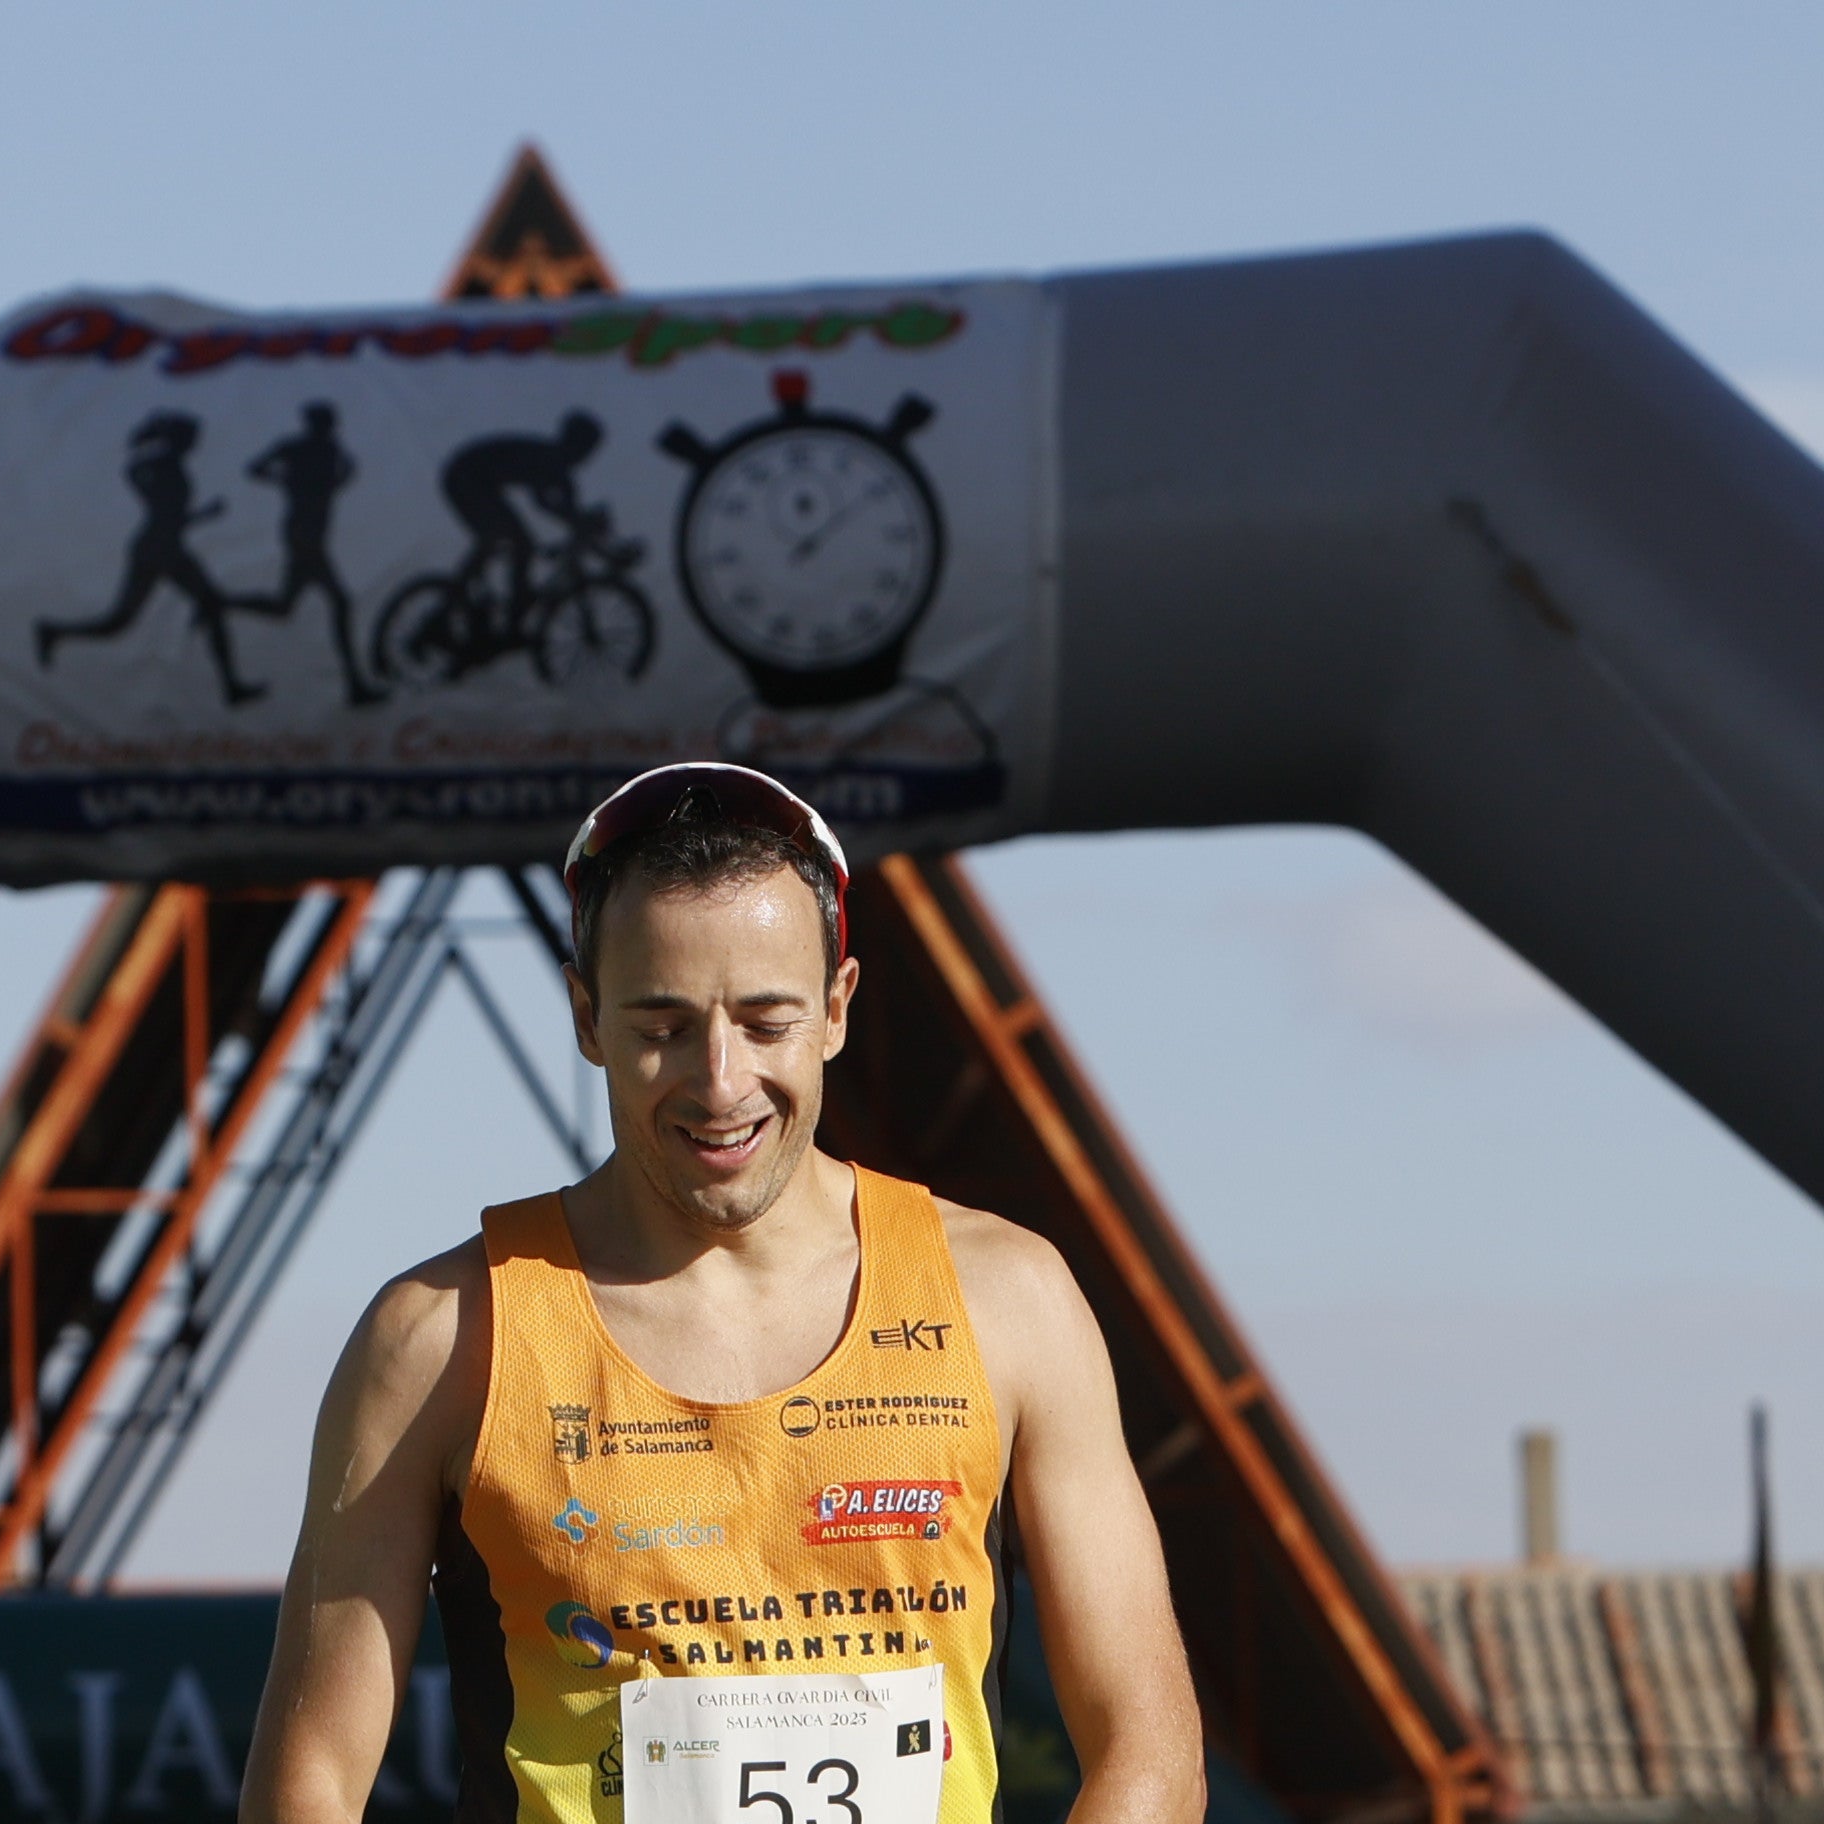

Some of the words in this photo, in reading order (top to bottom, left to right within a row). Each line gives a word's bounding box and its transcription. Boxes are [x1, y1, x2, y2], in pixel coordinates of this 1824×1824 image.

[870, 1319, 952, 1351] EKT
[825, 1398, 876, 1413] ESTER
[881, 1394, 968, 1410] RODRÍGUEZ
[598, 1417, 711, 1438] Ayuntamiento
[826, 1413, 900, 1430] CLÍNICA
[906, 1413, 969, 1429] DENTAL
[601, 1440, 619, 1457] de
[625, 1438, 714, 1454] Salamanca
[872, 1488, 944, 1514] ELICES
[613, 1518, 724, 1552] Sardón
[821, 1523, 916, 1539] AUTOESCUELA
[610, 1596, 783, 1630] ESCUELA
[696, 1691, 773, 1708] CARRERA
[725, 1713, 824, 1730] SALAMANCA
[829, 1711, 867, 1728] 2025
[672, 1739, 721, 1752] ALCER
